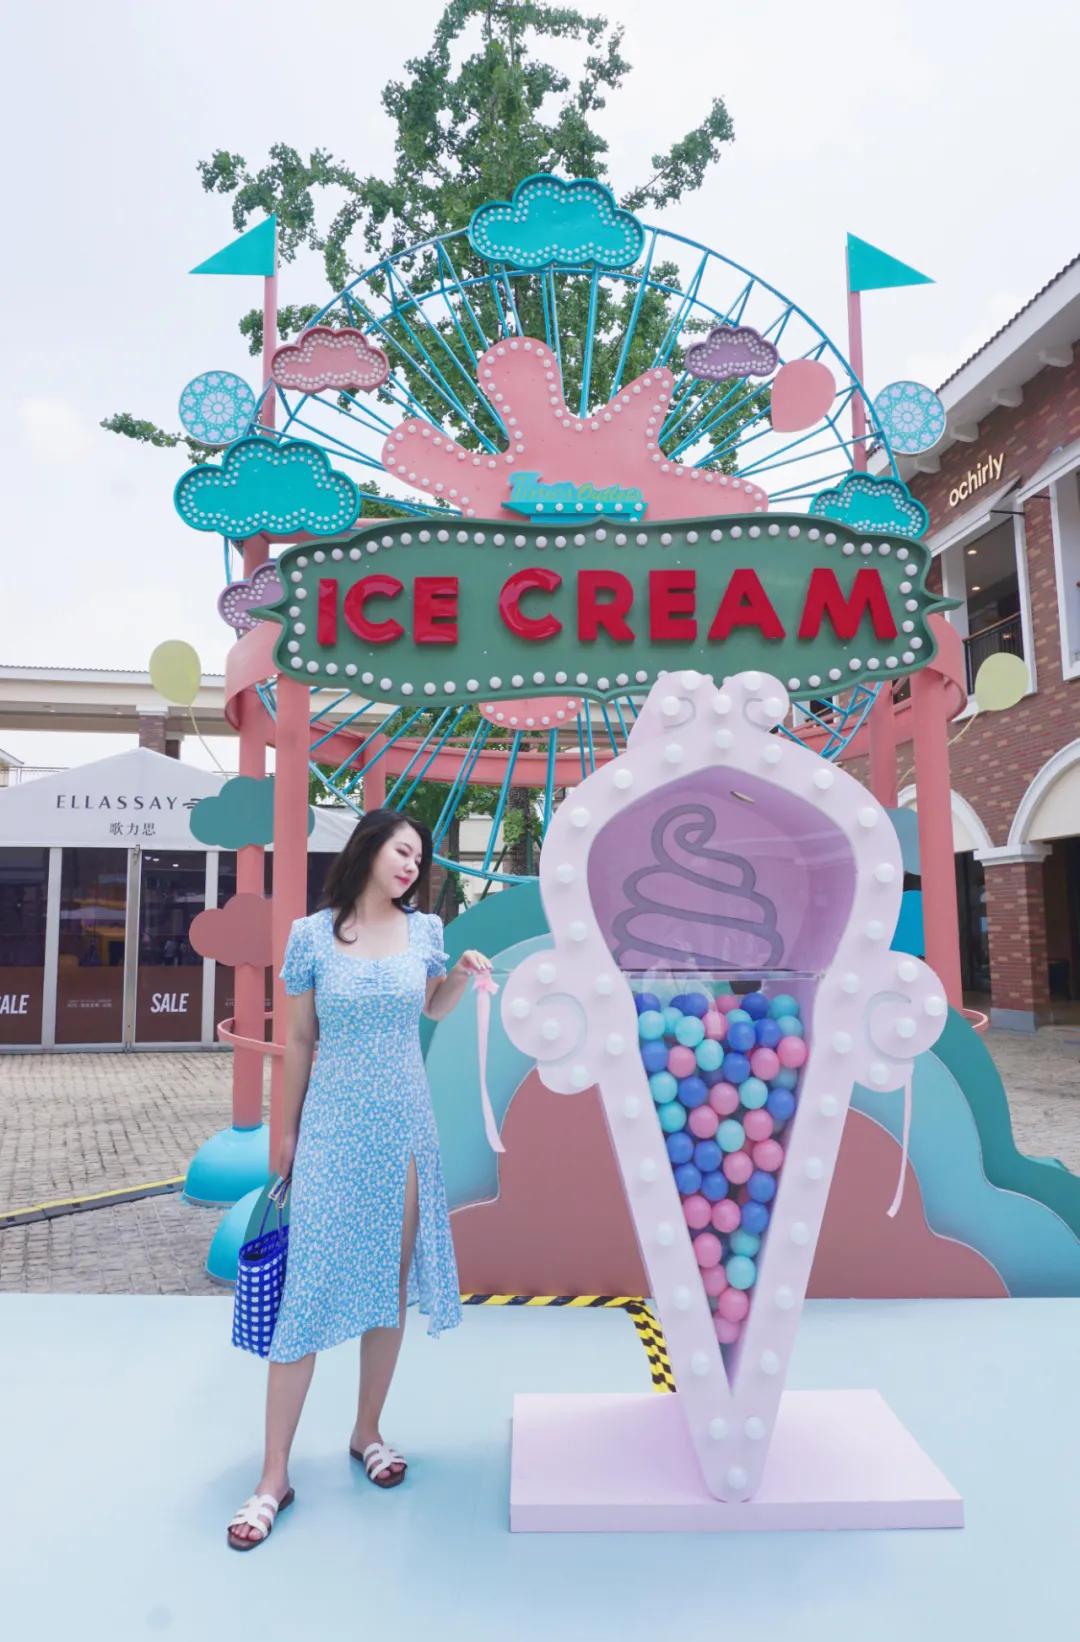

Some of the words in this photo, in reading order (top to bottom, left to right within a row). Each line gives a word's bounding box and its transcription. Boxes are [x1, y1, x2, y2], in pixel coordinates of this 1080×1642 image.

[949, 453, 1004, 507] ochirly
[317, 573, 459, 646] ICE
[499, 567, 899, 642] CREAM
[56, 794, 179, 810] ELLASSAY
[109, 822, 156, 836] 歌力思
[0, 994, 30, 1014] ALE
[150, 992, 190, 1013] SALE
